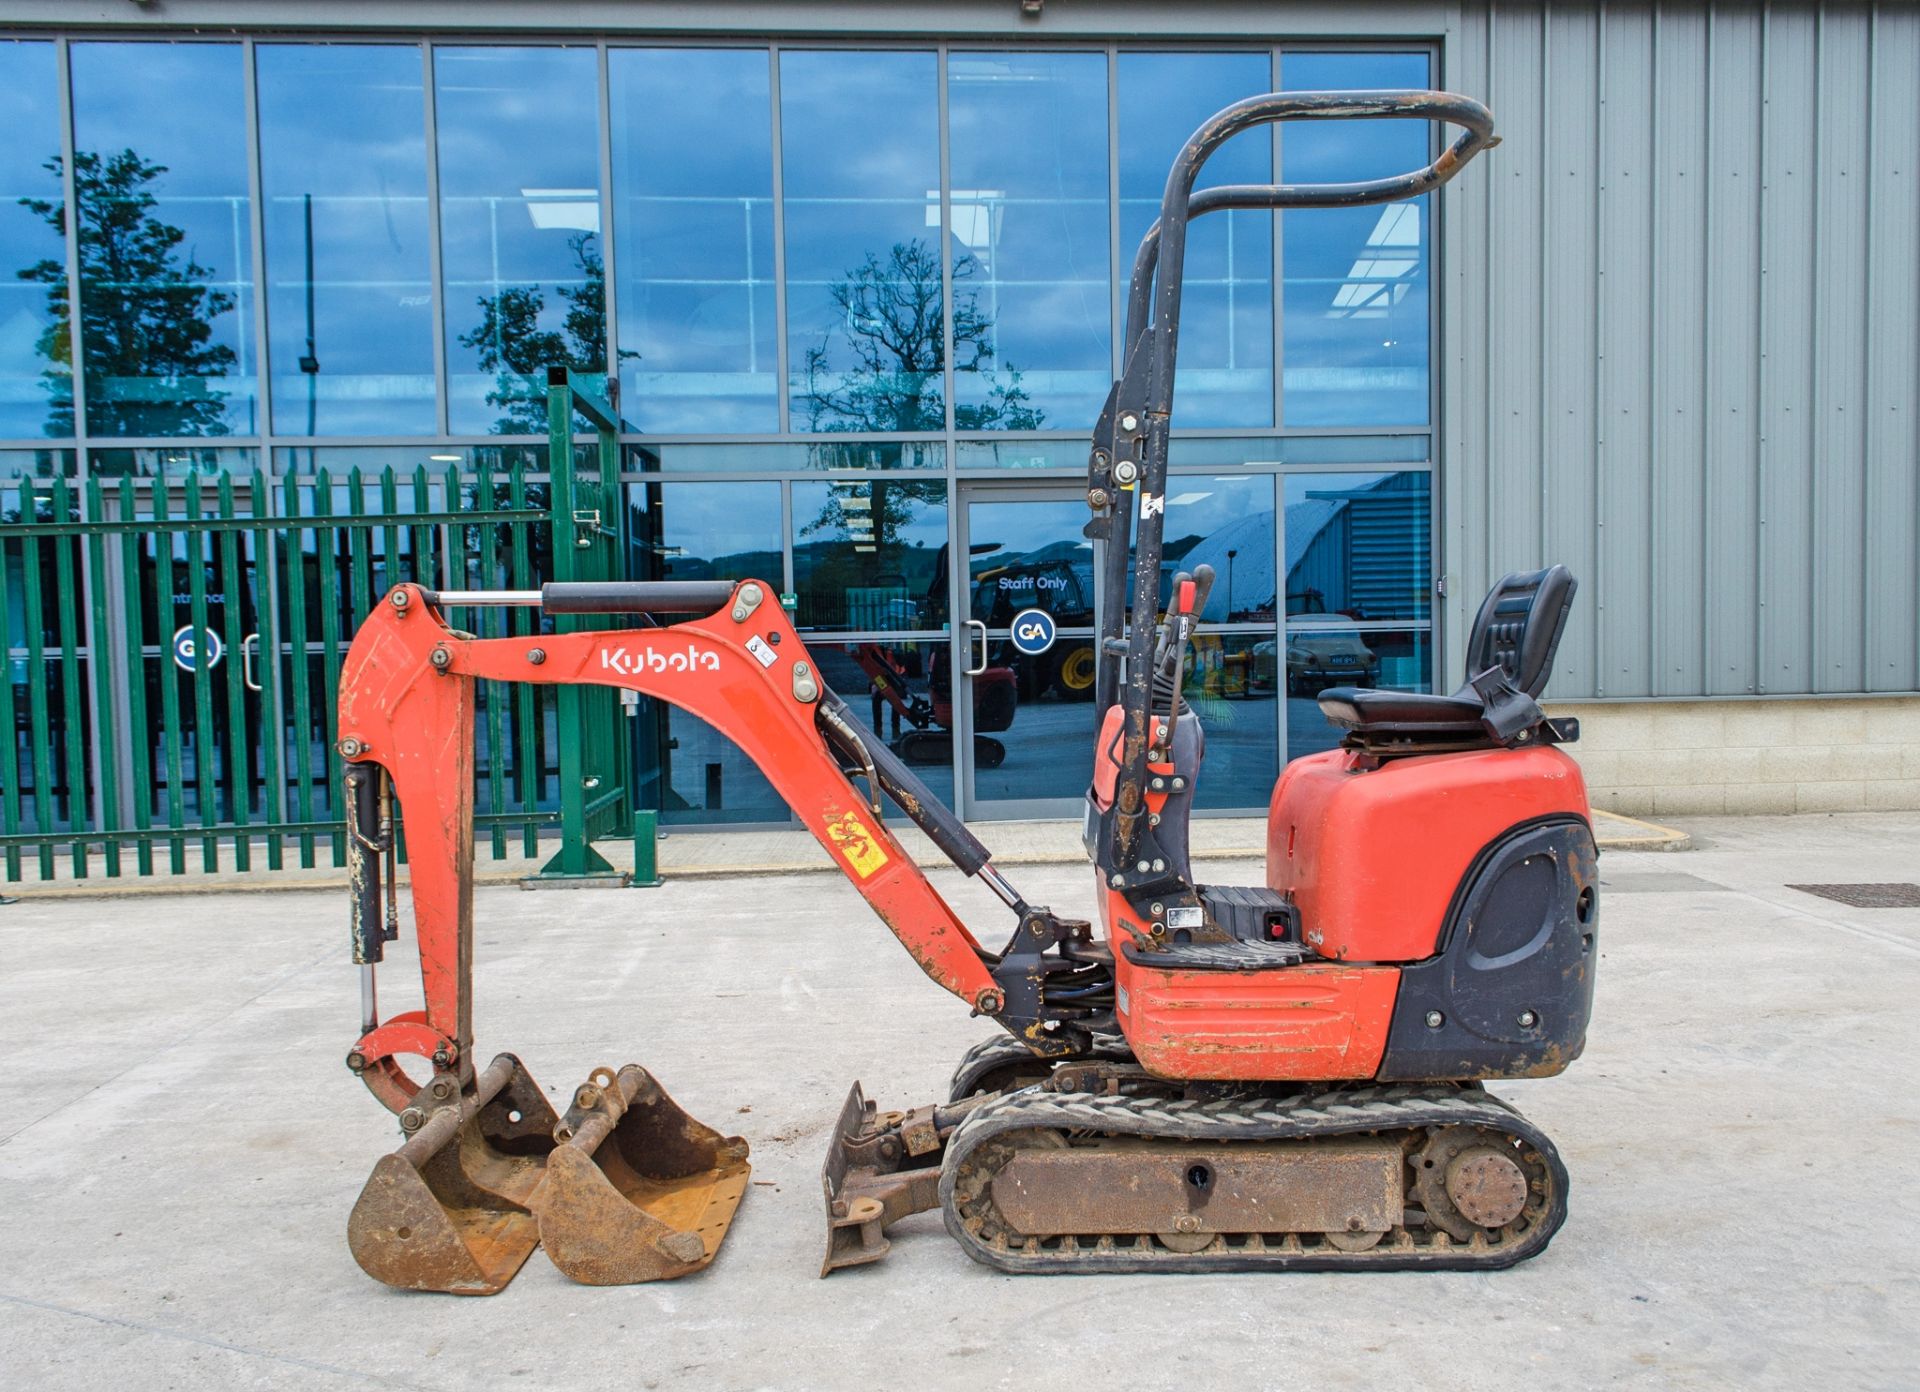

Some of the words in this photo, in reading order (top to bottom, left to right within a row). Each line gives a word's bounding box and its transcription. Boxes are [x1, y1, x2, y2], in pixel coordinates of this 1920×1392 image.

[999, 577, 1034, 590] Staff
[1036, 576, 1068, 592] Only
[1018, 623, 1048, 641] GA
[601, 645, 721, 675] Kubota
